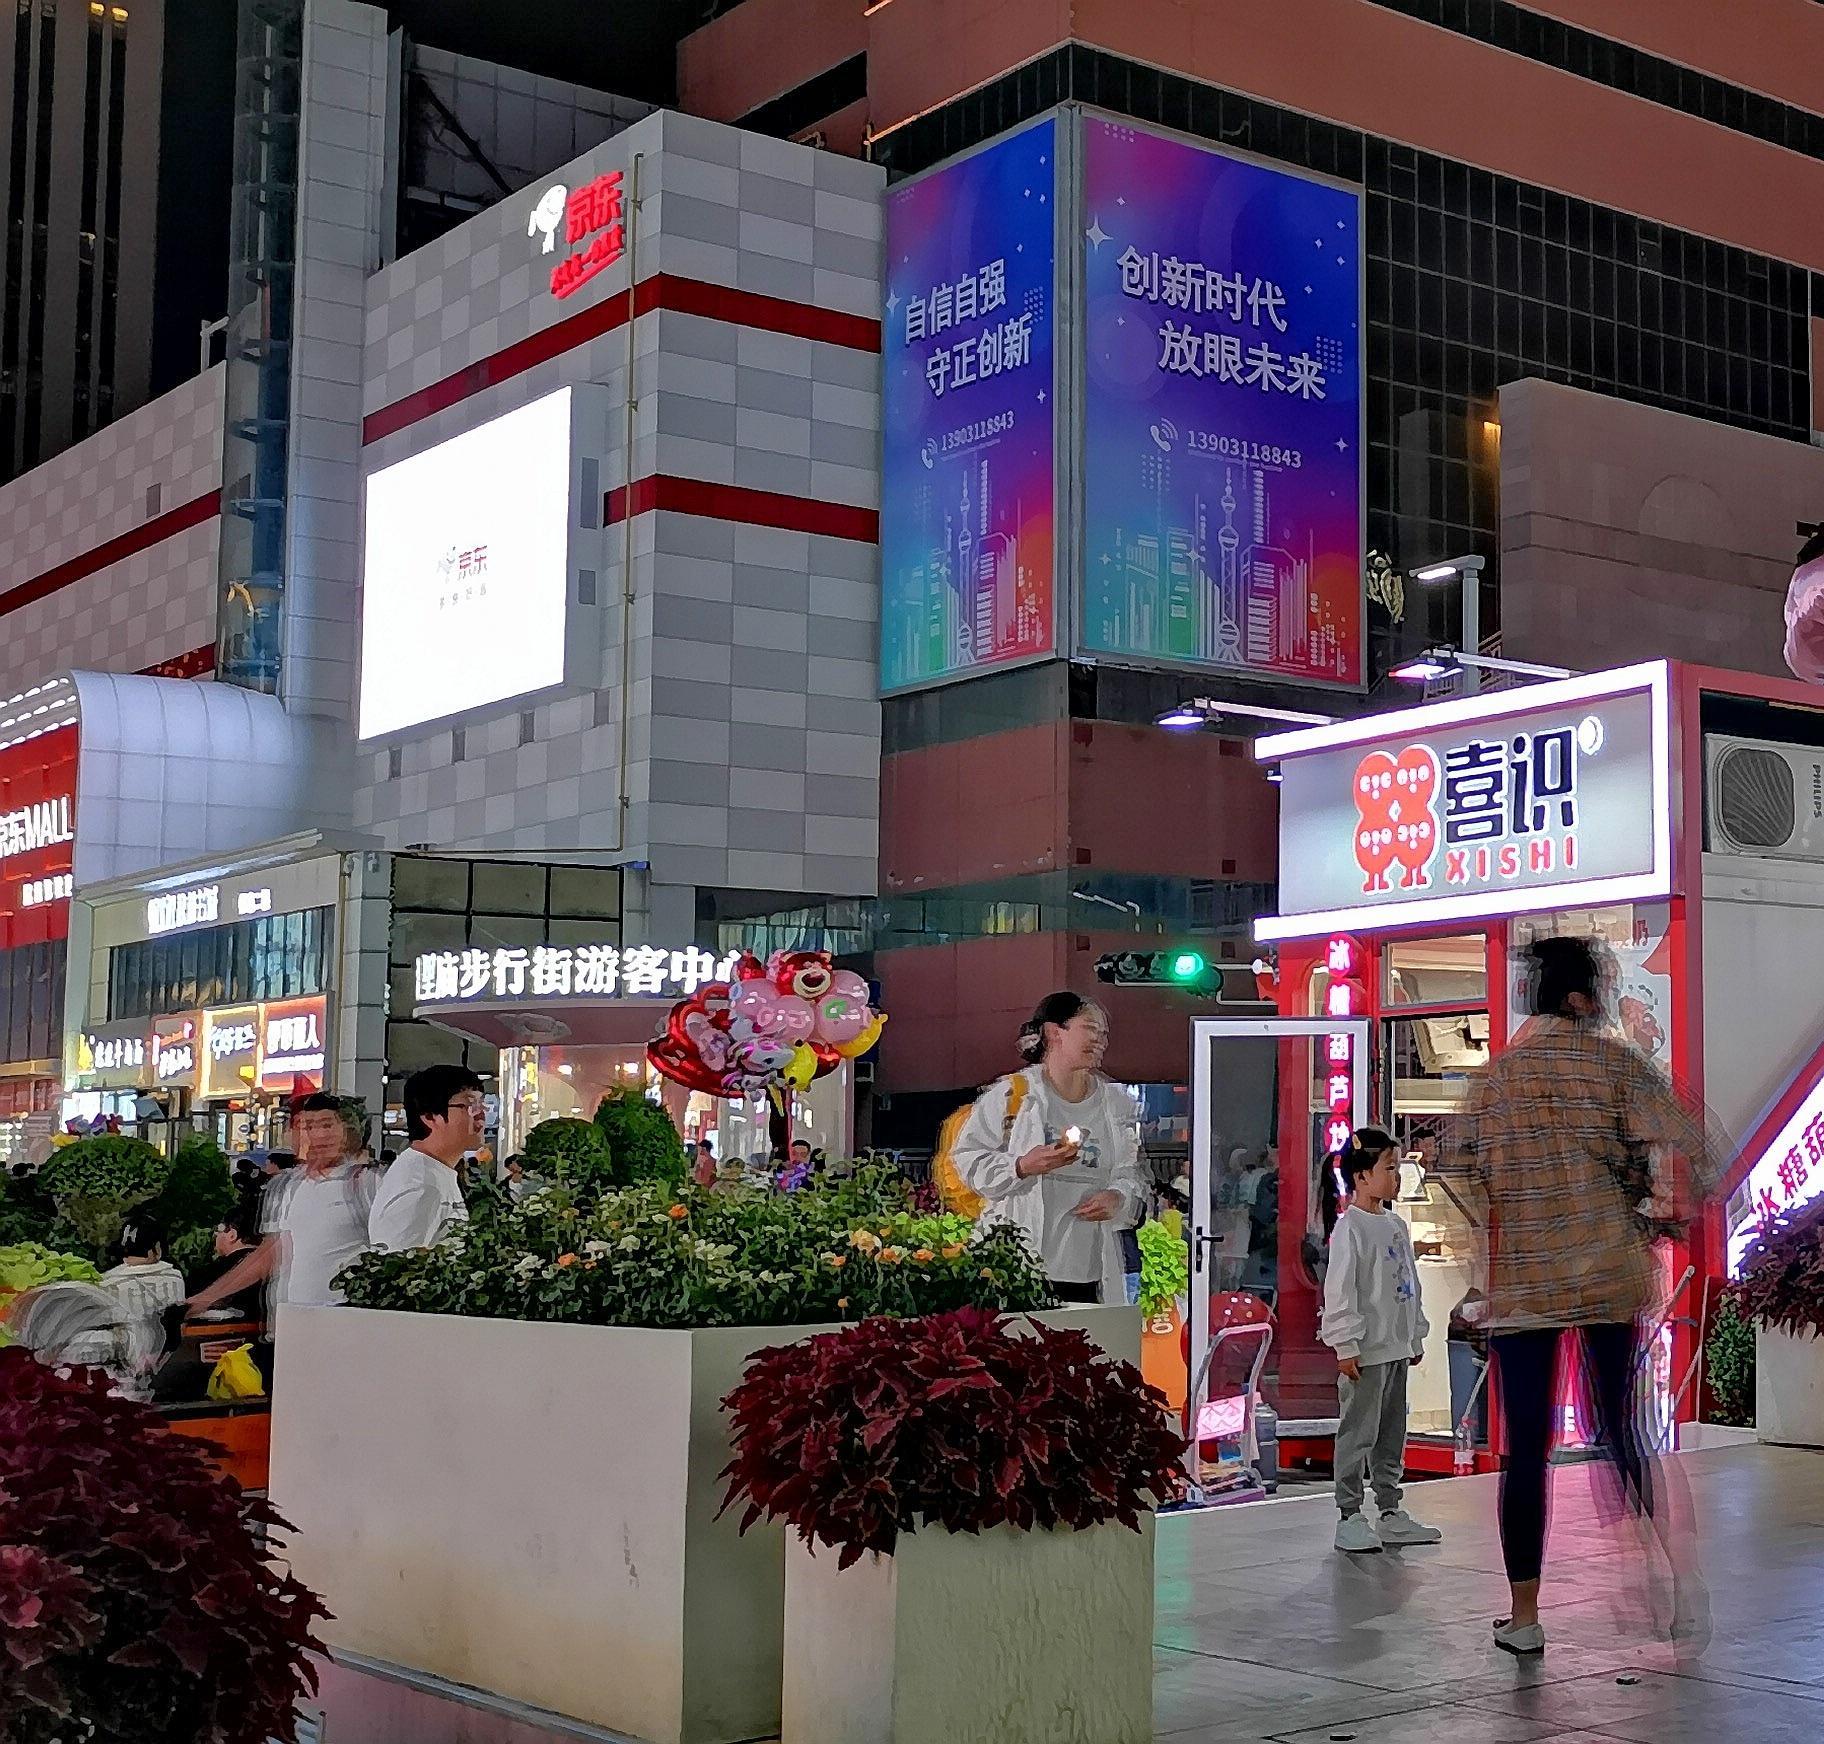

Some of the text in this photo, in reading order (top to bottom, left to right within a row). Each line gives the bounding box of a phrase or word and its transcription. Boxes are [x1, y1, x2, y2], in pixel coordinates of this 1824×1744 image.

[566, 170, 624, 245] 京东
[905, 258, 1006, 345] 自信自强
[1116, 244, 1287, 332] 创新时代
[925, 312, 1032, 397] 守正创新
[1158, 320, 1327, 400] 放眼未来
[1187, 429, 1302, 469] 13903118843
[458, 544, 488, 581] 京东
[1444, 727, 1580, 846] 喜识
[1812, 763, 1823, 819] PHILIPS
[1444, 831, 1580, 885] XISHI
